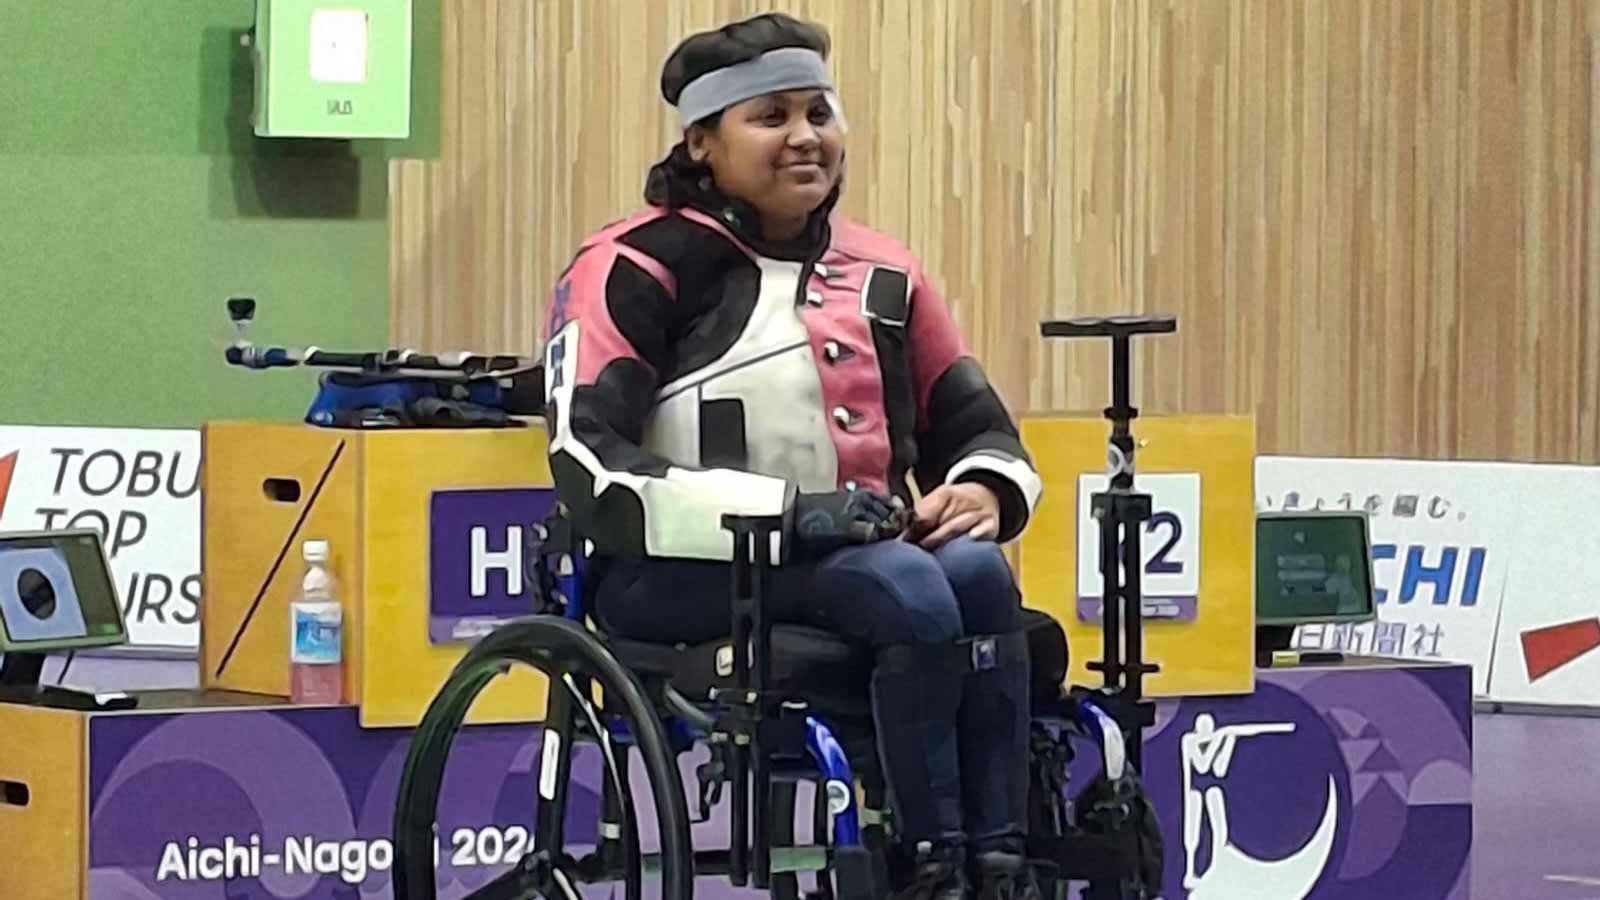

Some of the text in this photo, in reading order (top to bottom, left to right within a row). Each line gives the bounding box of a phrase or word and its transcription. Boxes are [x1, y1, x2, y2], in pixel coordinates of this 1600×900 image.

[51, 448, 200, 498] TOBU
[471, 525, 522, 597] H
[157, 834, 439, 884] Aichi-Nago
